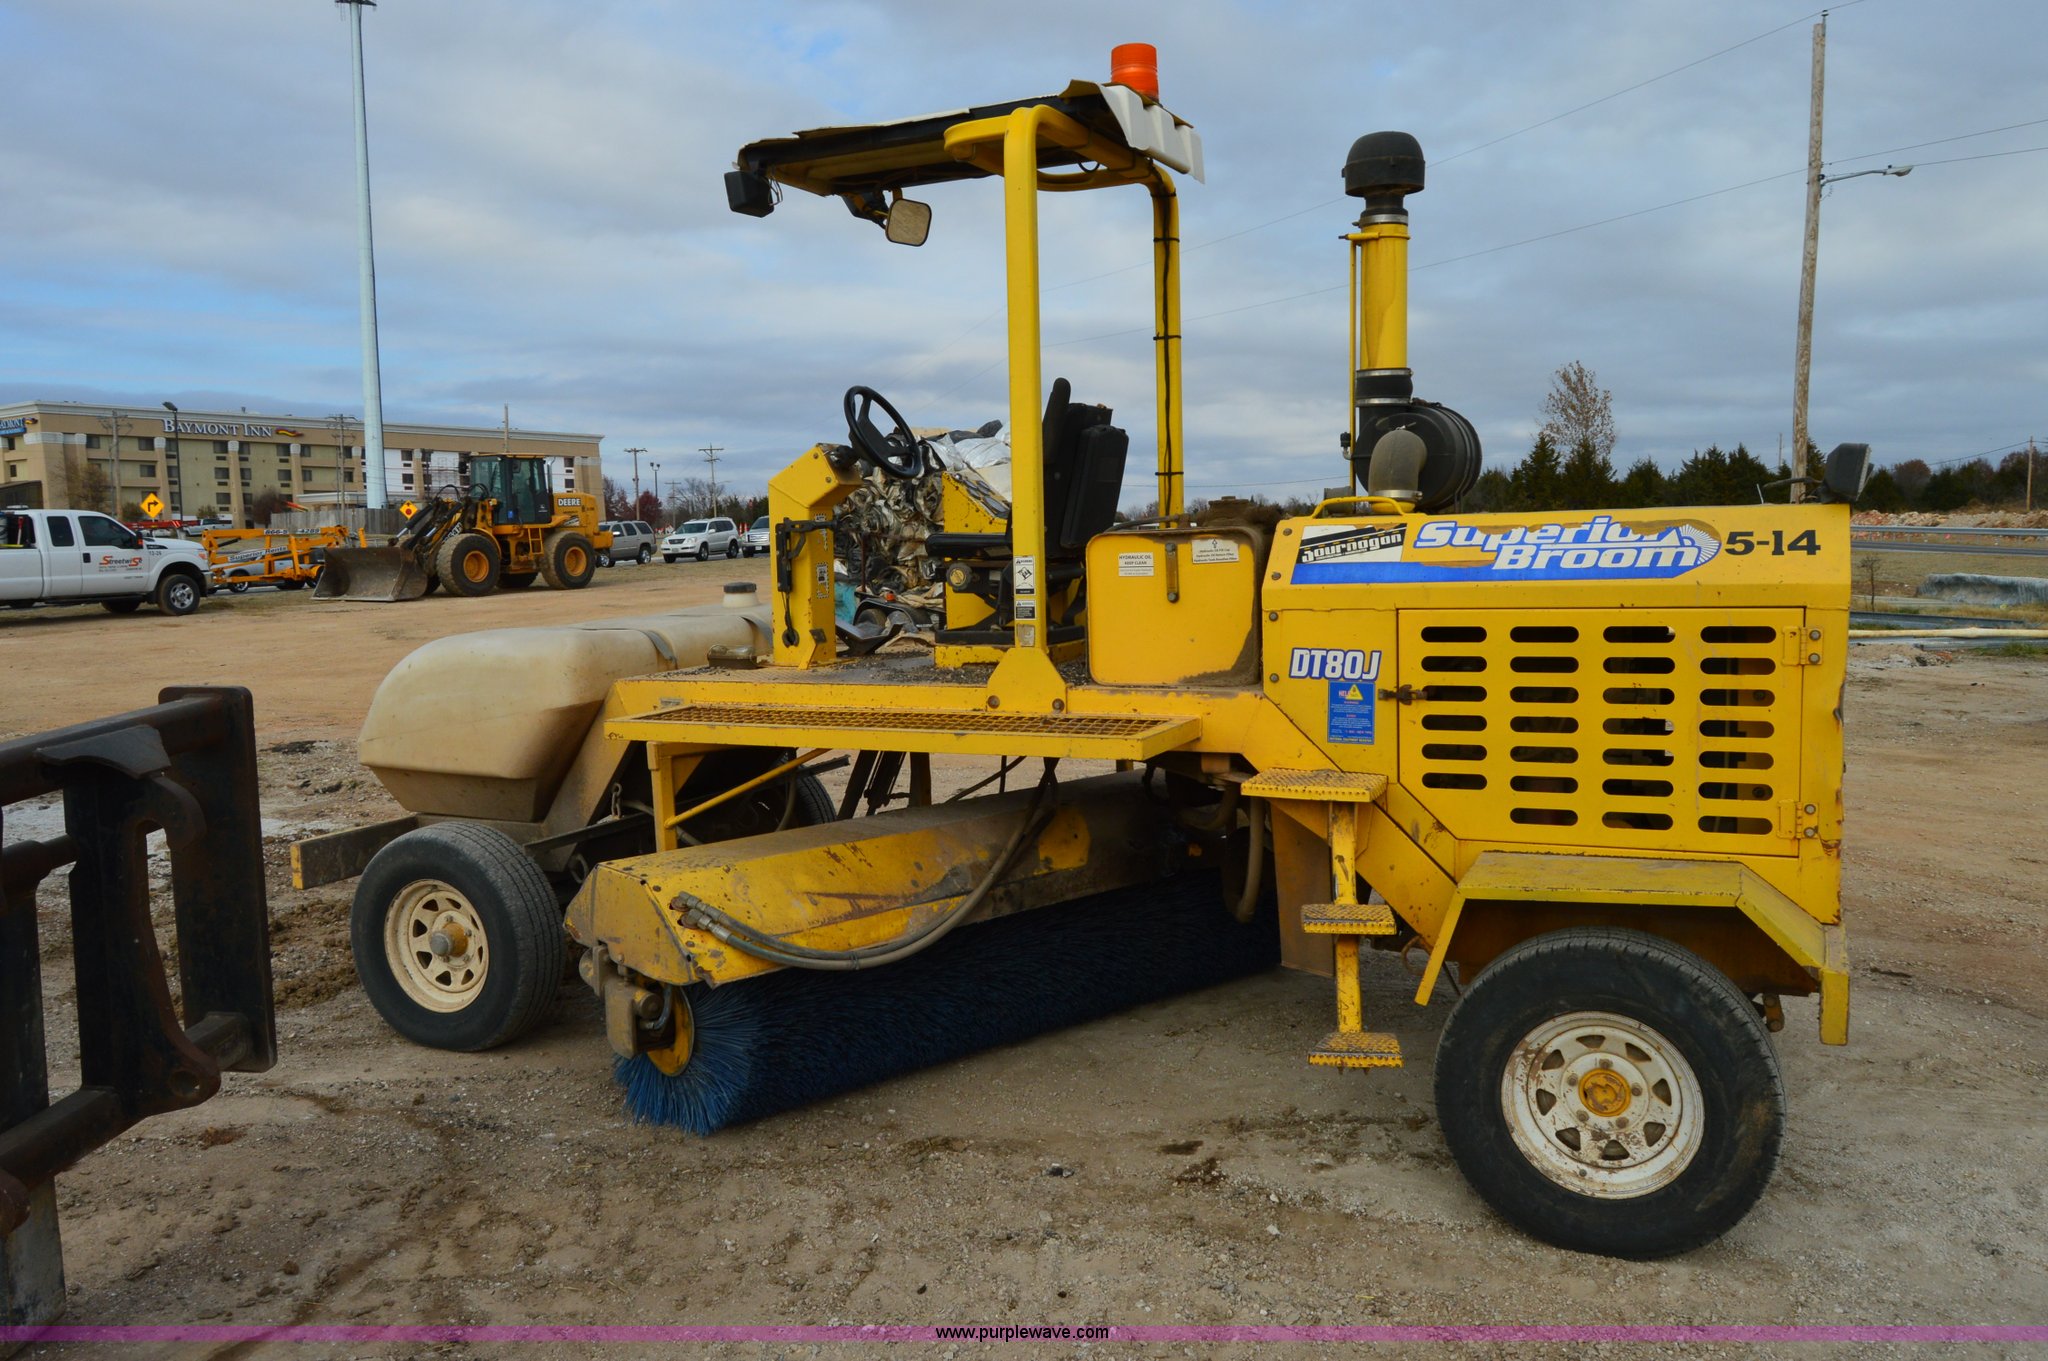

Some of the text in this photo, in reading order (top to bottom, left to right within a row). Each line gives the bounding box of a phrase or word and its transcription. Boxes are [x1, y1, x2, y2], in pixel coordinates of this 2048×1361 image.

[163, 418, 273, 437] BAYMONT INN
[557, 498, 582, 507] DEERE
[1724, 529, 1822, 556] 5-14
[1491, 544, 1700, 570] Broom
[1289, 648, 1381, 681] DT80J
